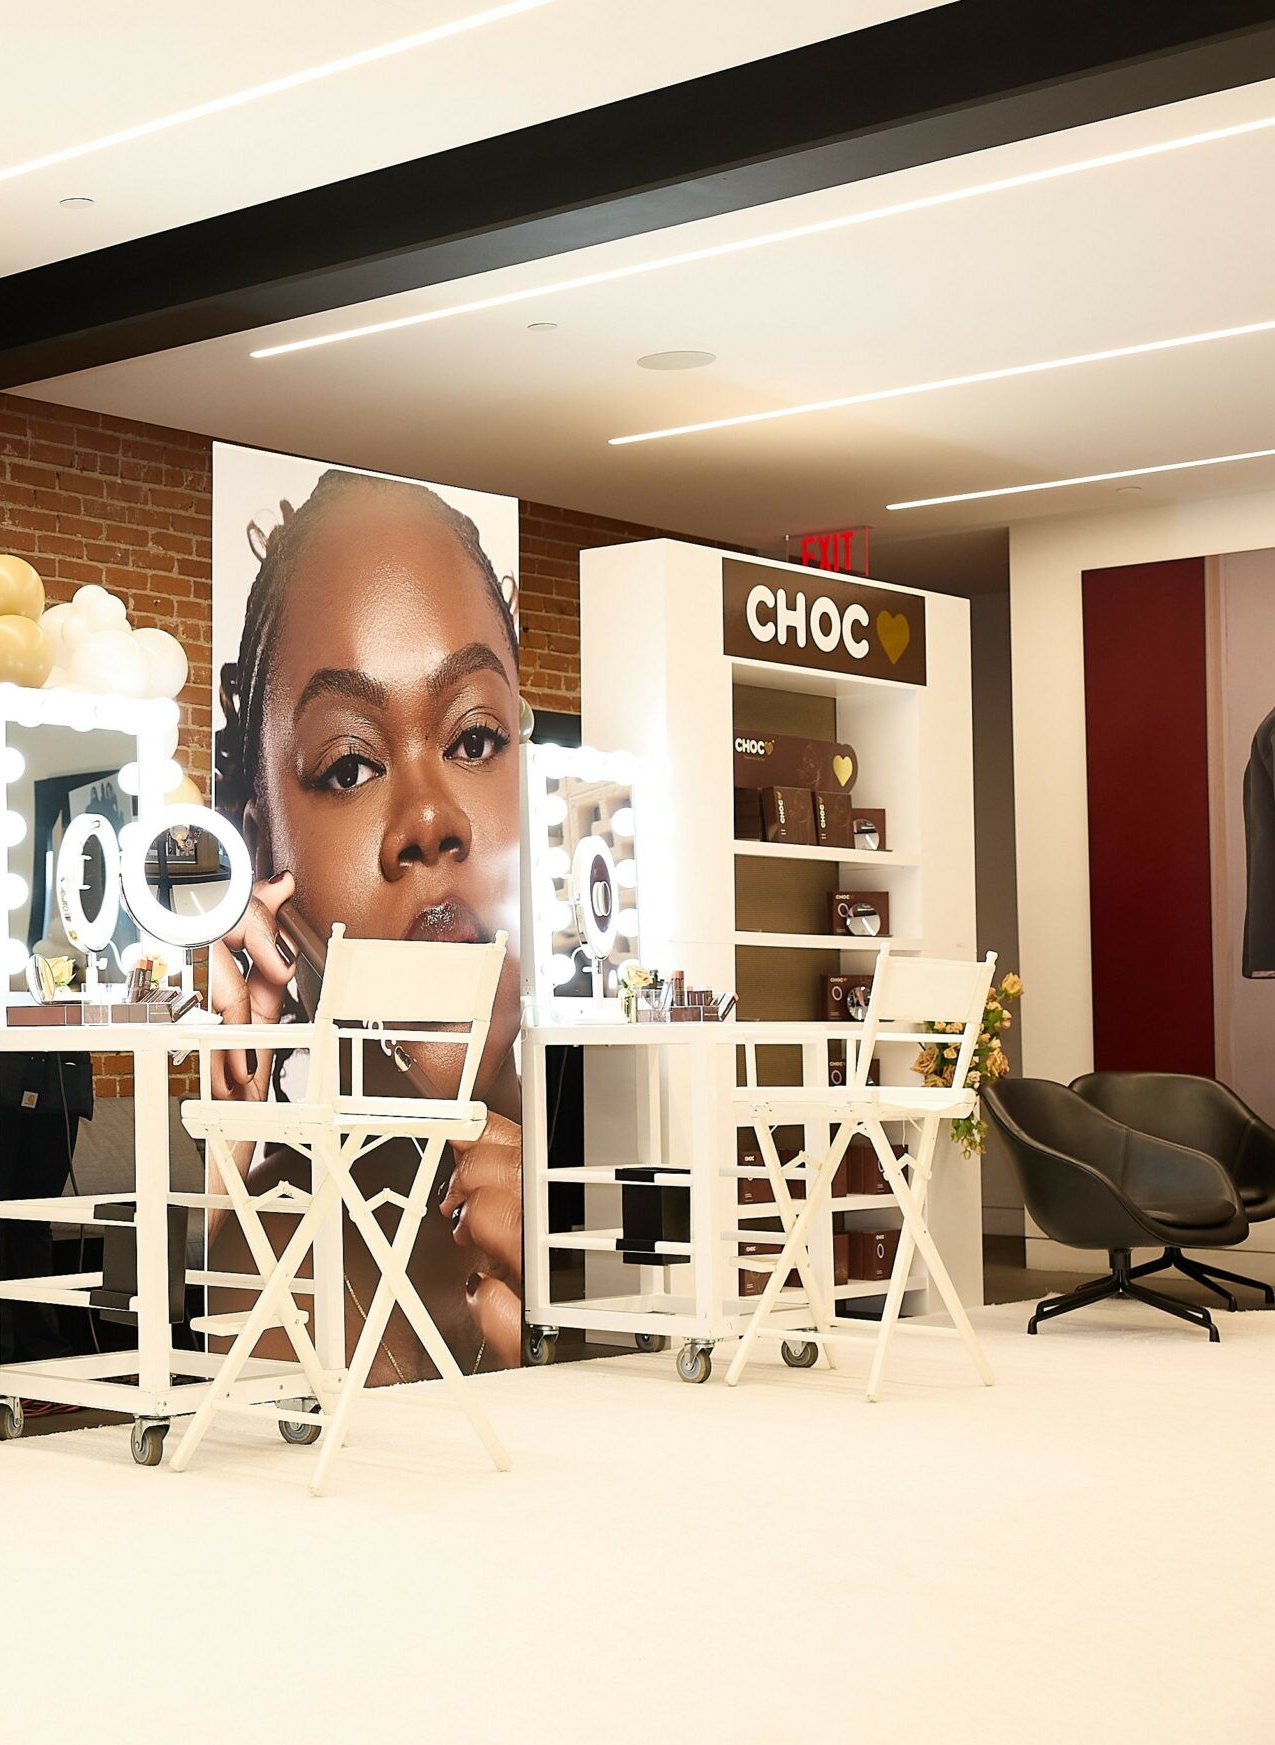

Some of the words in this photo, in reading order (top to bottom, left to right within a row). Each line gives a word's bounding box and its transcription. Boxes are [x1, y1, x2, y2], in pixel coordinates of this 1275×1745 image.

[802, 531, 854, 572] EXIT
[746, 584, 870, 659] CHOC
[734, 738, 765, 755] CHOC
